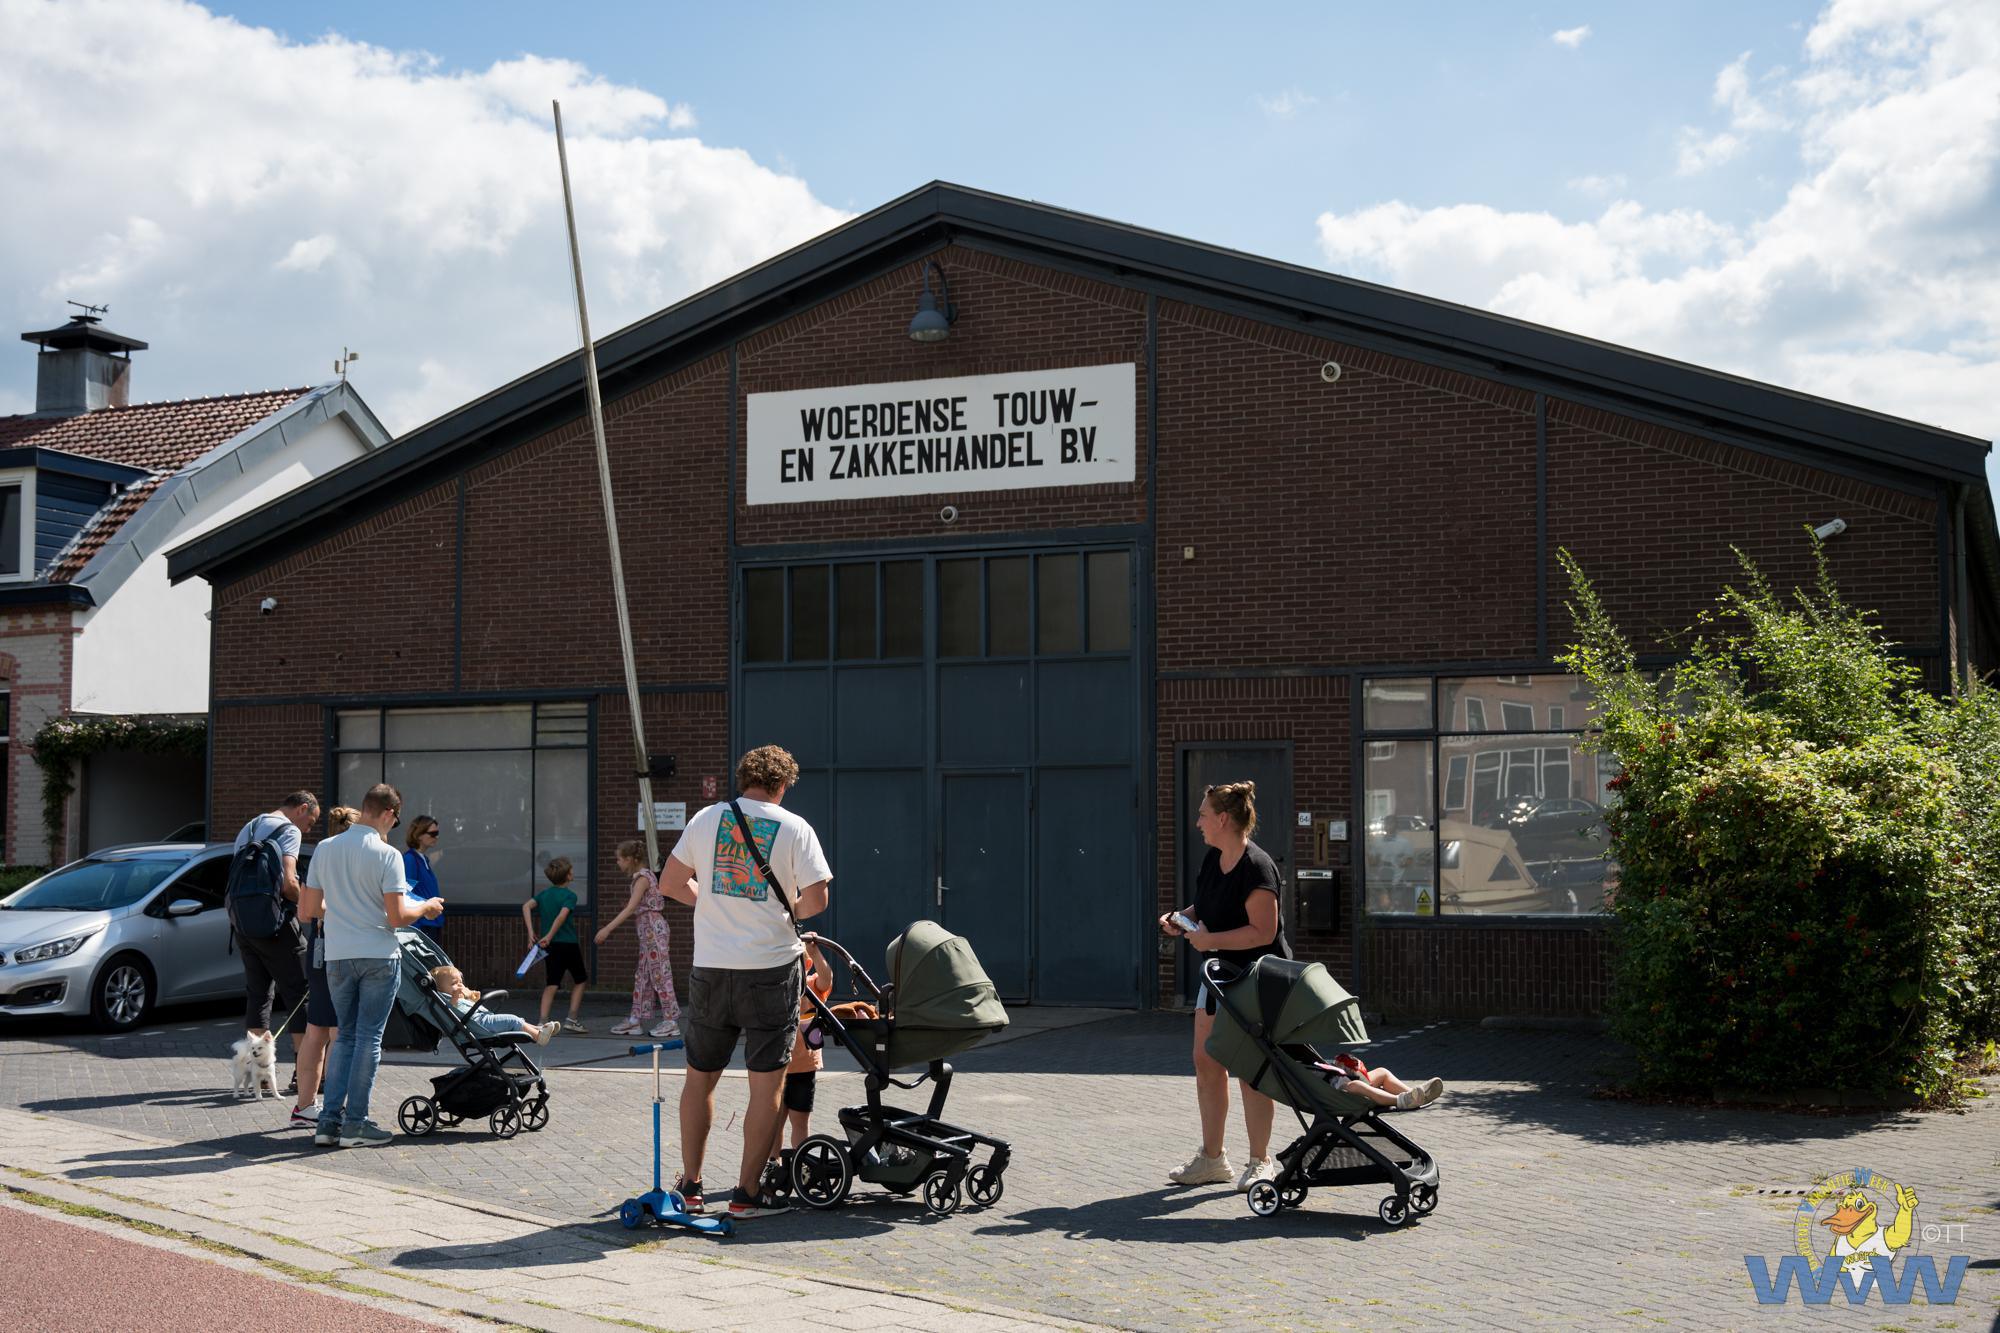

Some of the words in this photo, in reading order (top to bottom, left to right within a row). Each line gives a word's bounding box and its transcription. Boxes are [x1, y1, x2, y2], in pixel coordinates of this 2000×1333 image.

[801, 397, 968, 443] WOERDENSE
[994, 388, 1098, 428] TOUW-
[781, 448, 814, 484] EN
[829, 431, 1044, 480] ZAKKENHANDEL
[1061, 427, 1098, 464] B.V.
